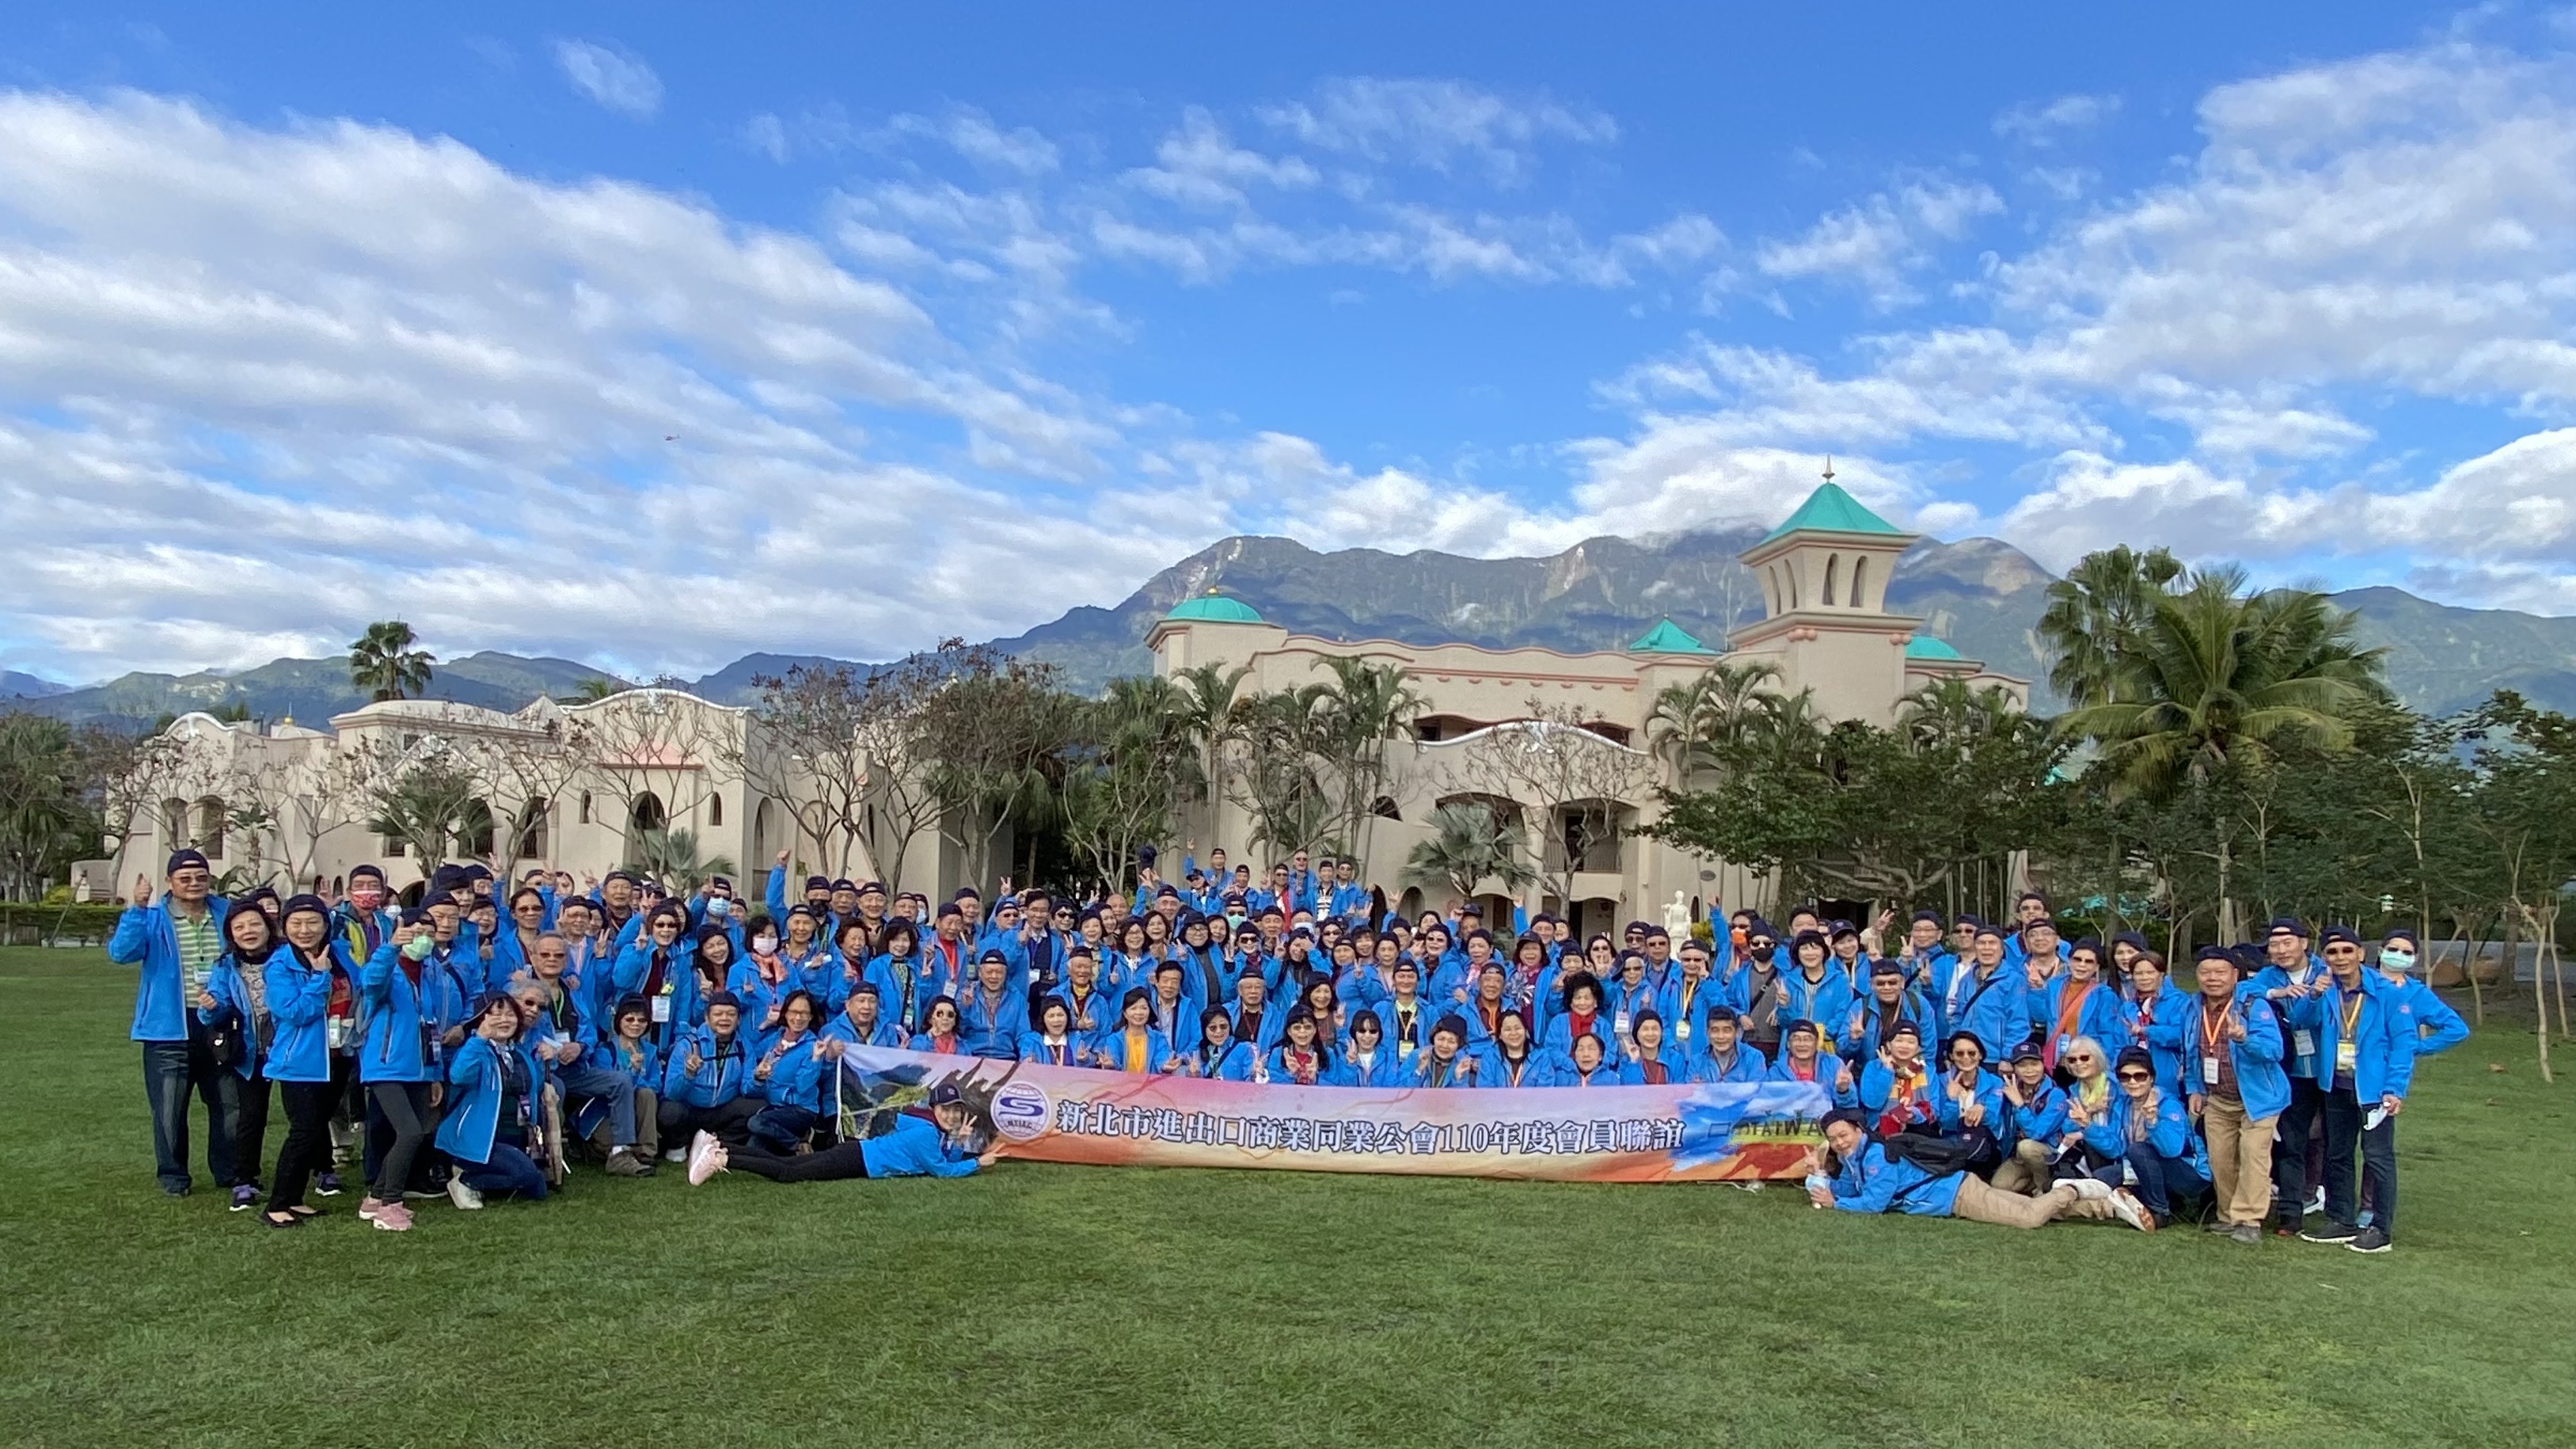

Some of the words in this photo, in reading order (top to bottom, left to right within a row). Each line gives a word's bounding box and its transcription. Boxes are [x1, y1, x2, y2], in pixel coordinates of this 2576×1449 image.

[1056, 1100, 1685, 1154] 新北市進出口商業同業公會110年度會員聯誼
[1751, 1111, 1823, 1136] TAIWA
